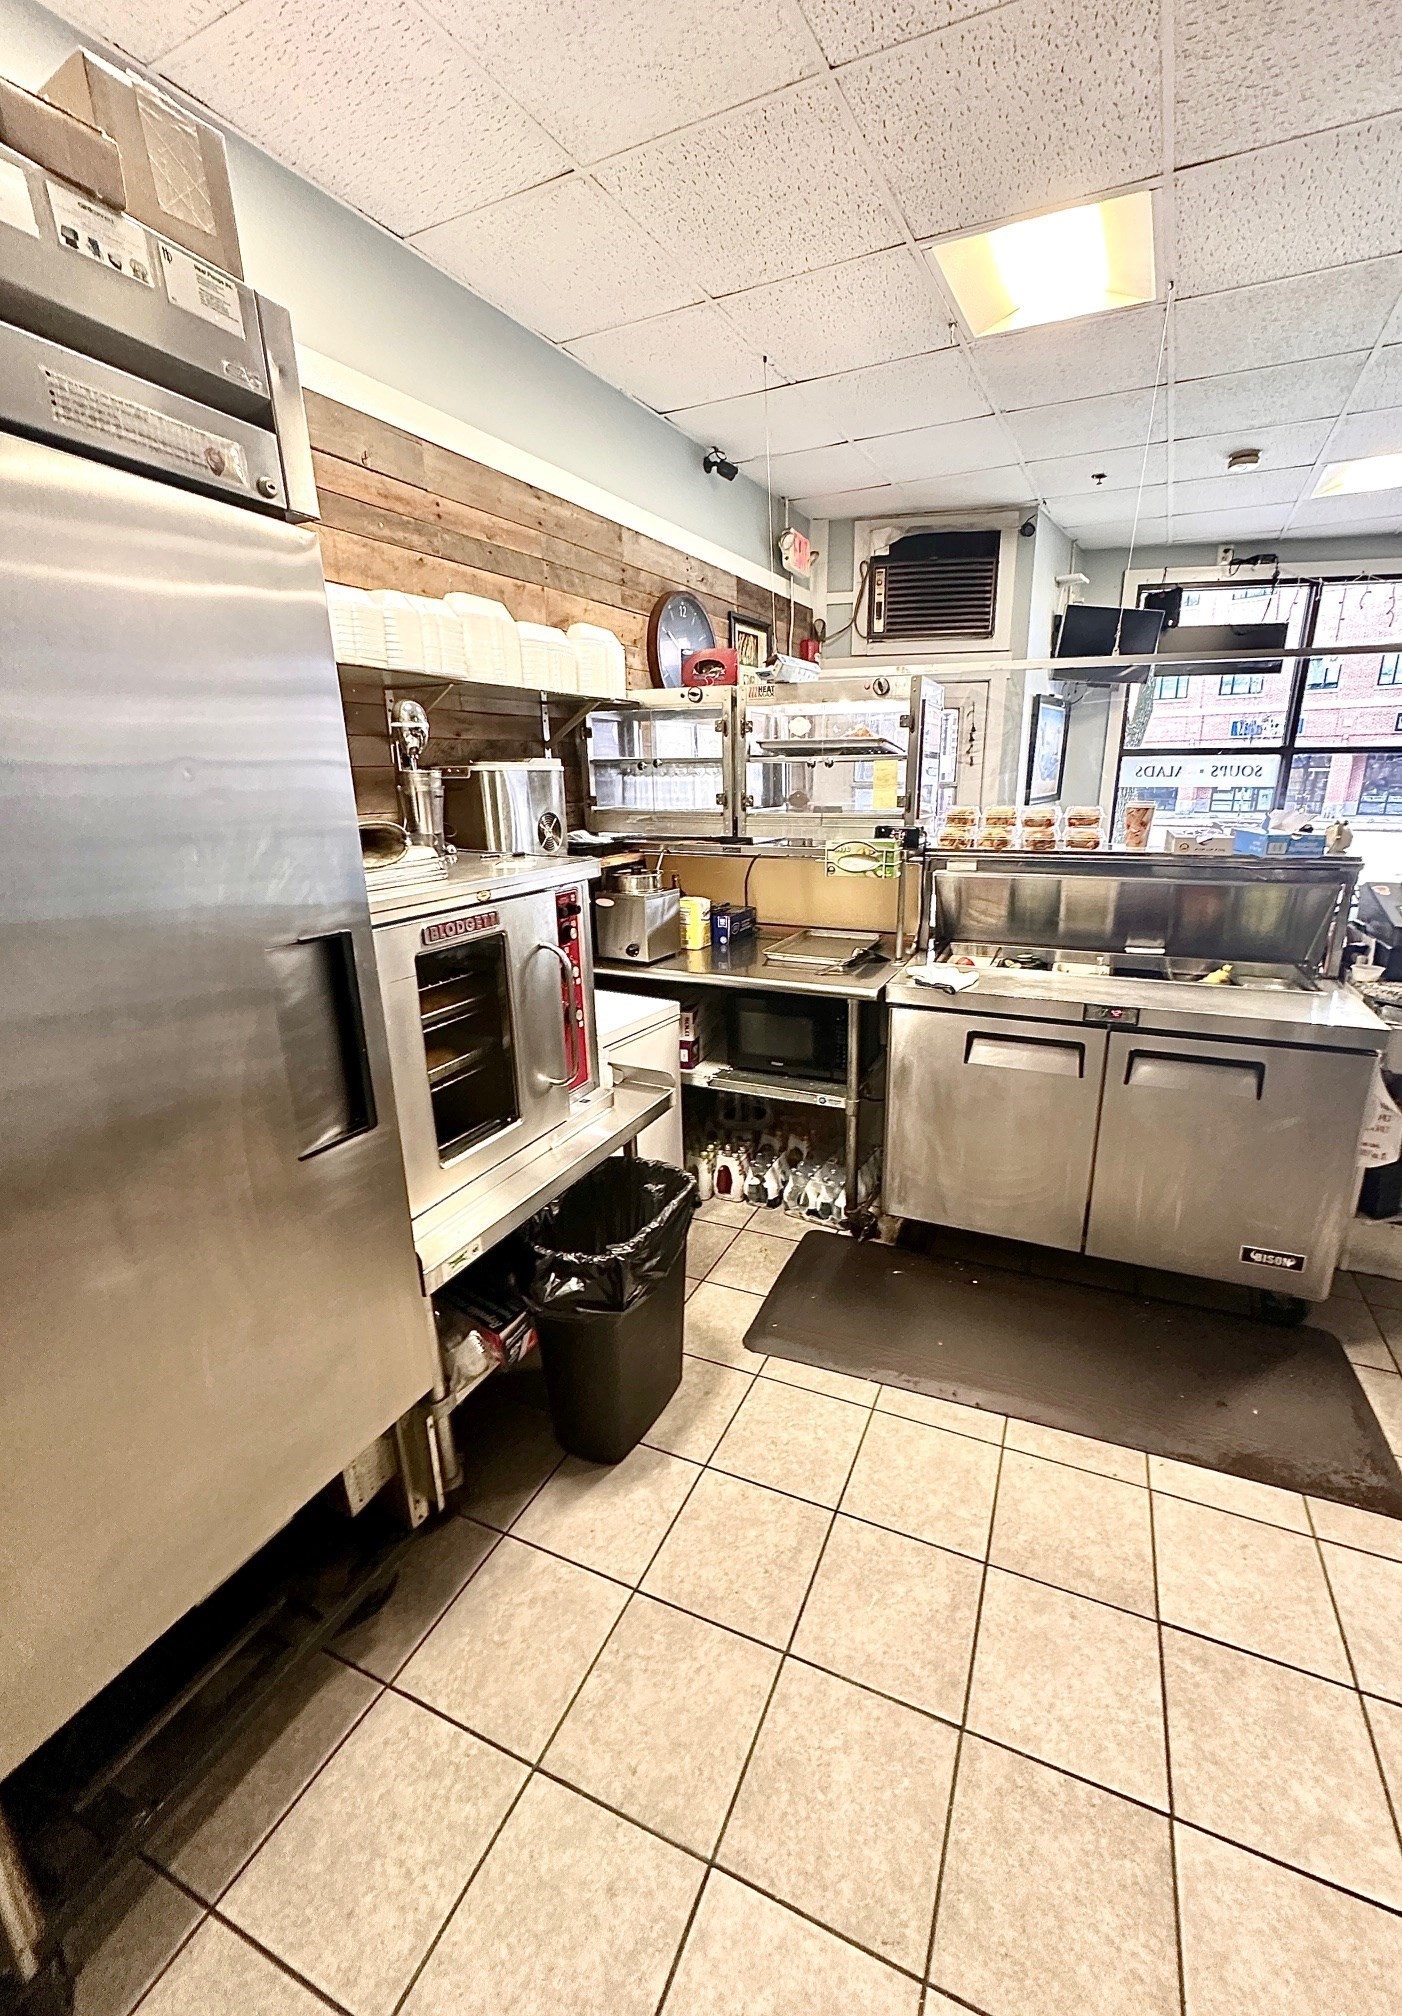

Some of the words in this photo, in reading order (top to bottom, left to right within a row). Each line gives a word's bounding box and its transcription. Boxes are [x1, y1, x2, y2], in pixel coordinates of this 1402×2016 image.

[679, 605, 687, 618] 12
[758, 685, 775, 693] HEAT
[428, 911, 498, 943] BLODGETT
